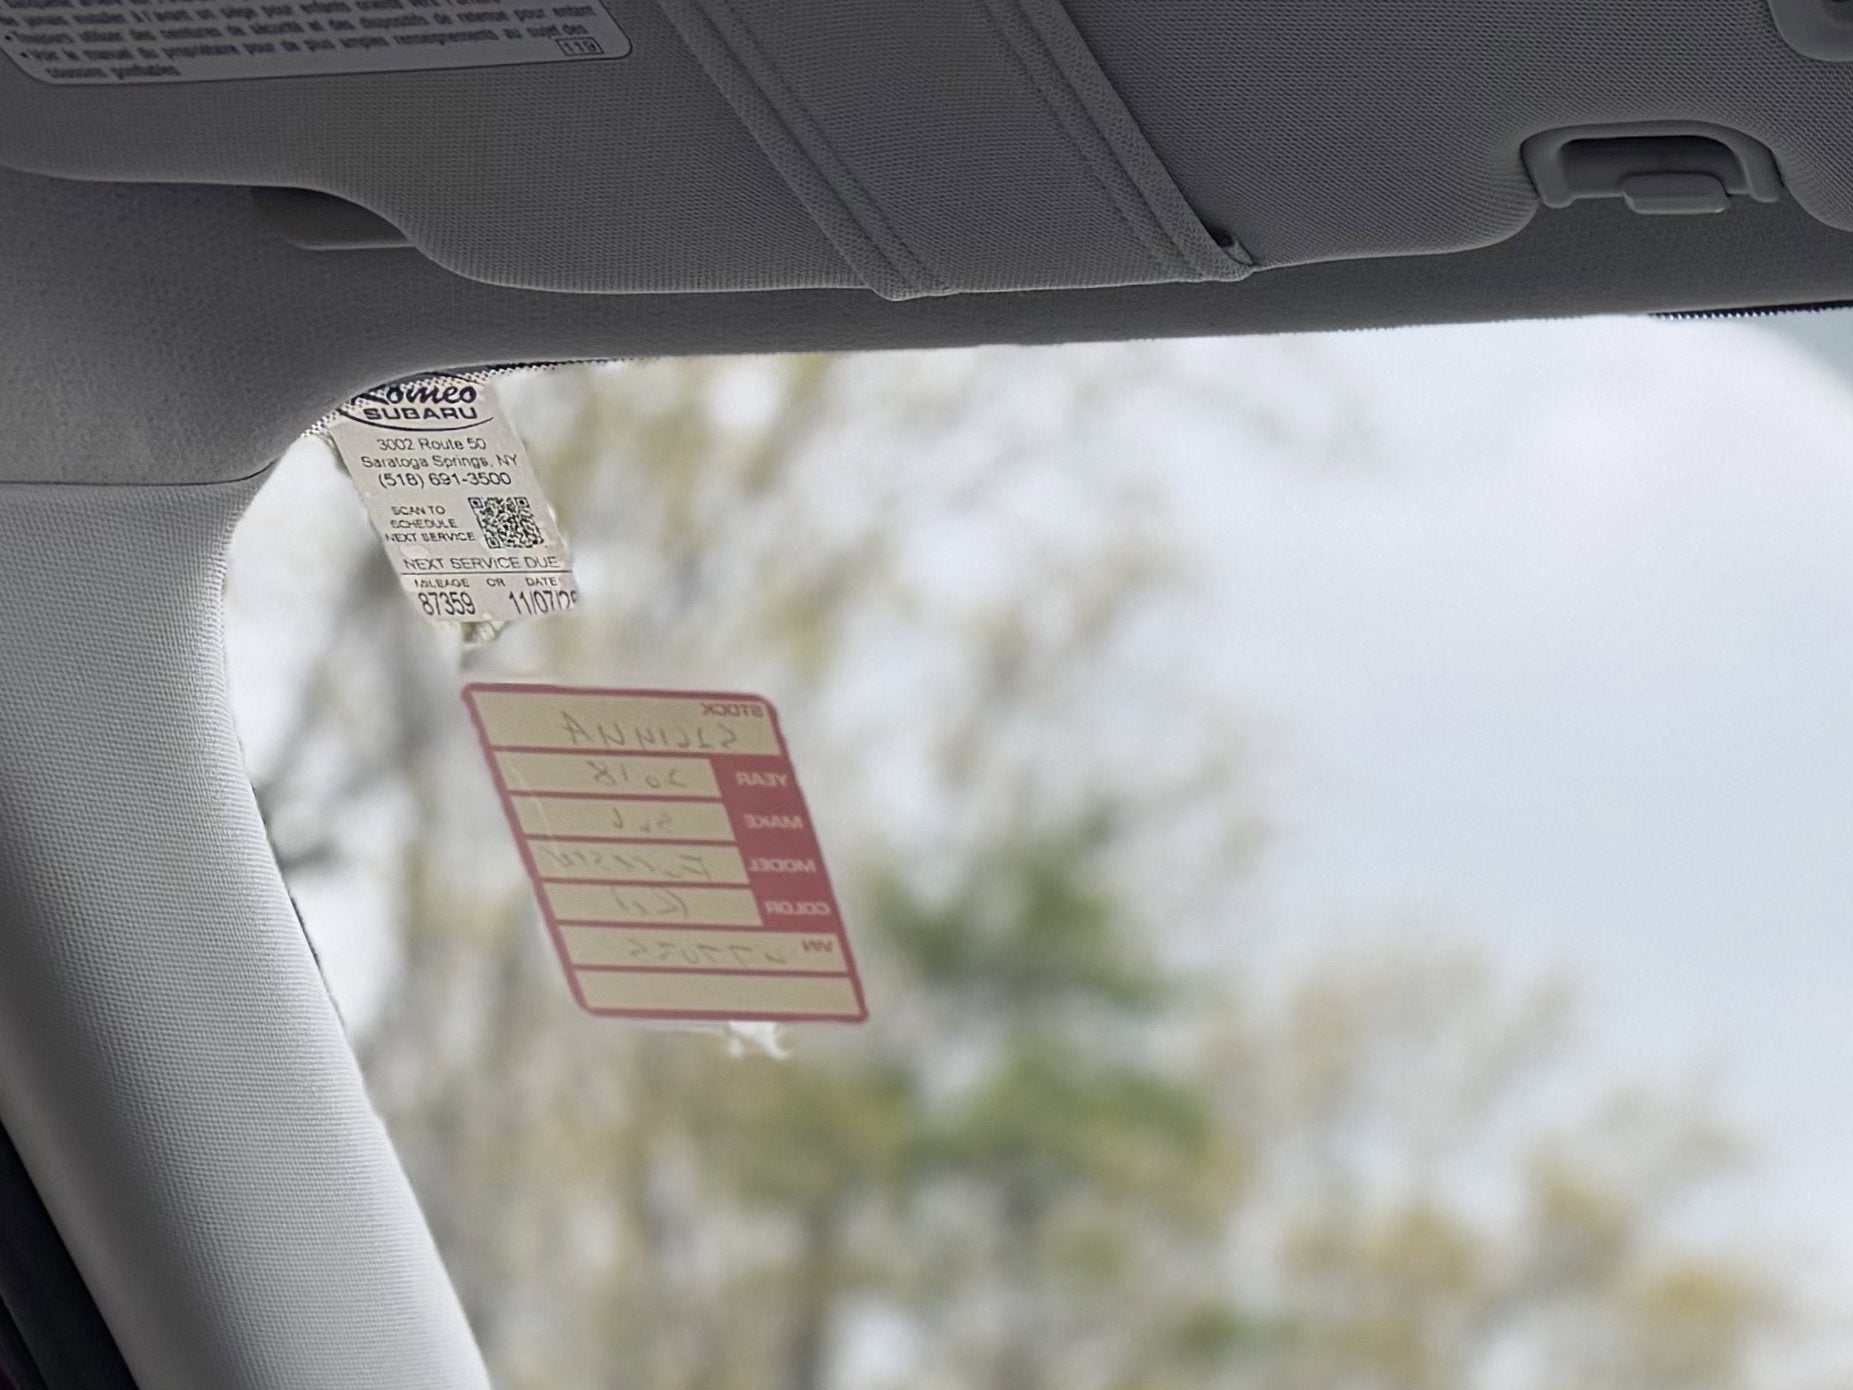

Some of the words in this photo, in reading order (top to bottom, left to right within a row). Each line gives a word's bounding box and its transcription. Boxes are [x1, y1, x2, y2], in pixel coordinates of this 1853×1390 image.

[563, 40, 598, 53] 119
[363, 407, 479, 420] SUBARU
[377, 438, 415, 451] 3002
[418, 437, 464, 451] Route
[466, 437, 487, 450] 50
[361, 456, 430, 470] Saratoga
[496, 454, 519, 466] NY
[378, 473, 425, 489] (518)
[429, 472, 512, 486] 691-3500
[392, 506, 426, 516] SCAN
[429, 505, 446, 516] TO
[391, 519, 459, 529] SCHEDULE
[385, 533, 418, 543] NEXT
[422, 532, 476, 542] SERVICE
[402, 558, 444, 570] NEXT
[449, 557, 520, 570] SERVICE
[524, 556, 561, 569] DUE
[525, 577, 559, 587] DATE
[418, 591, 476, 615] 87359
